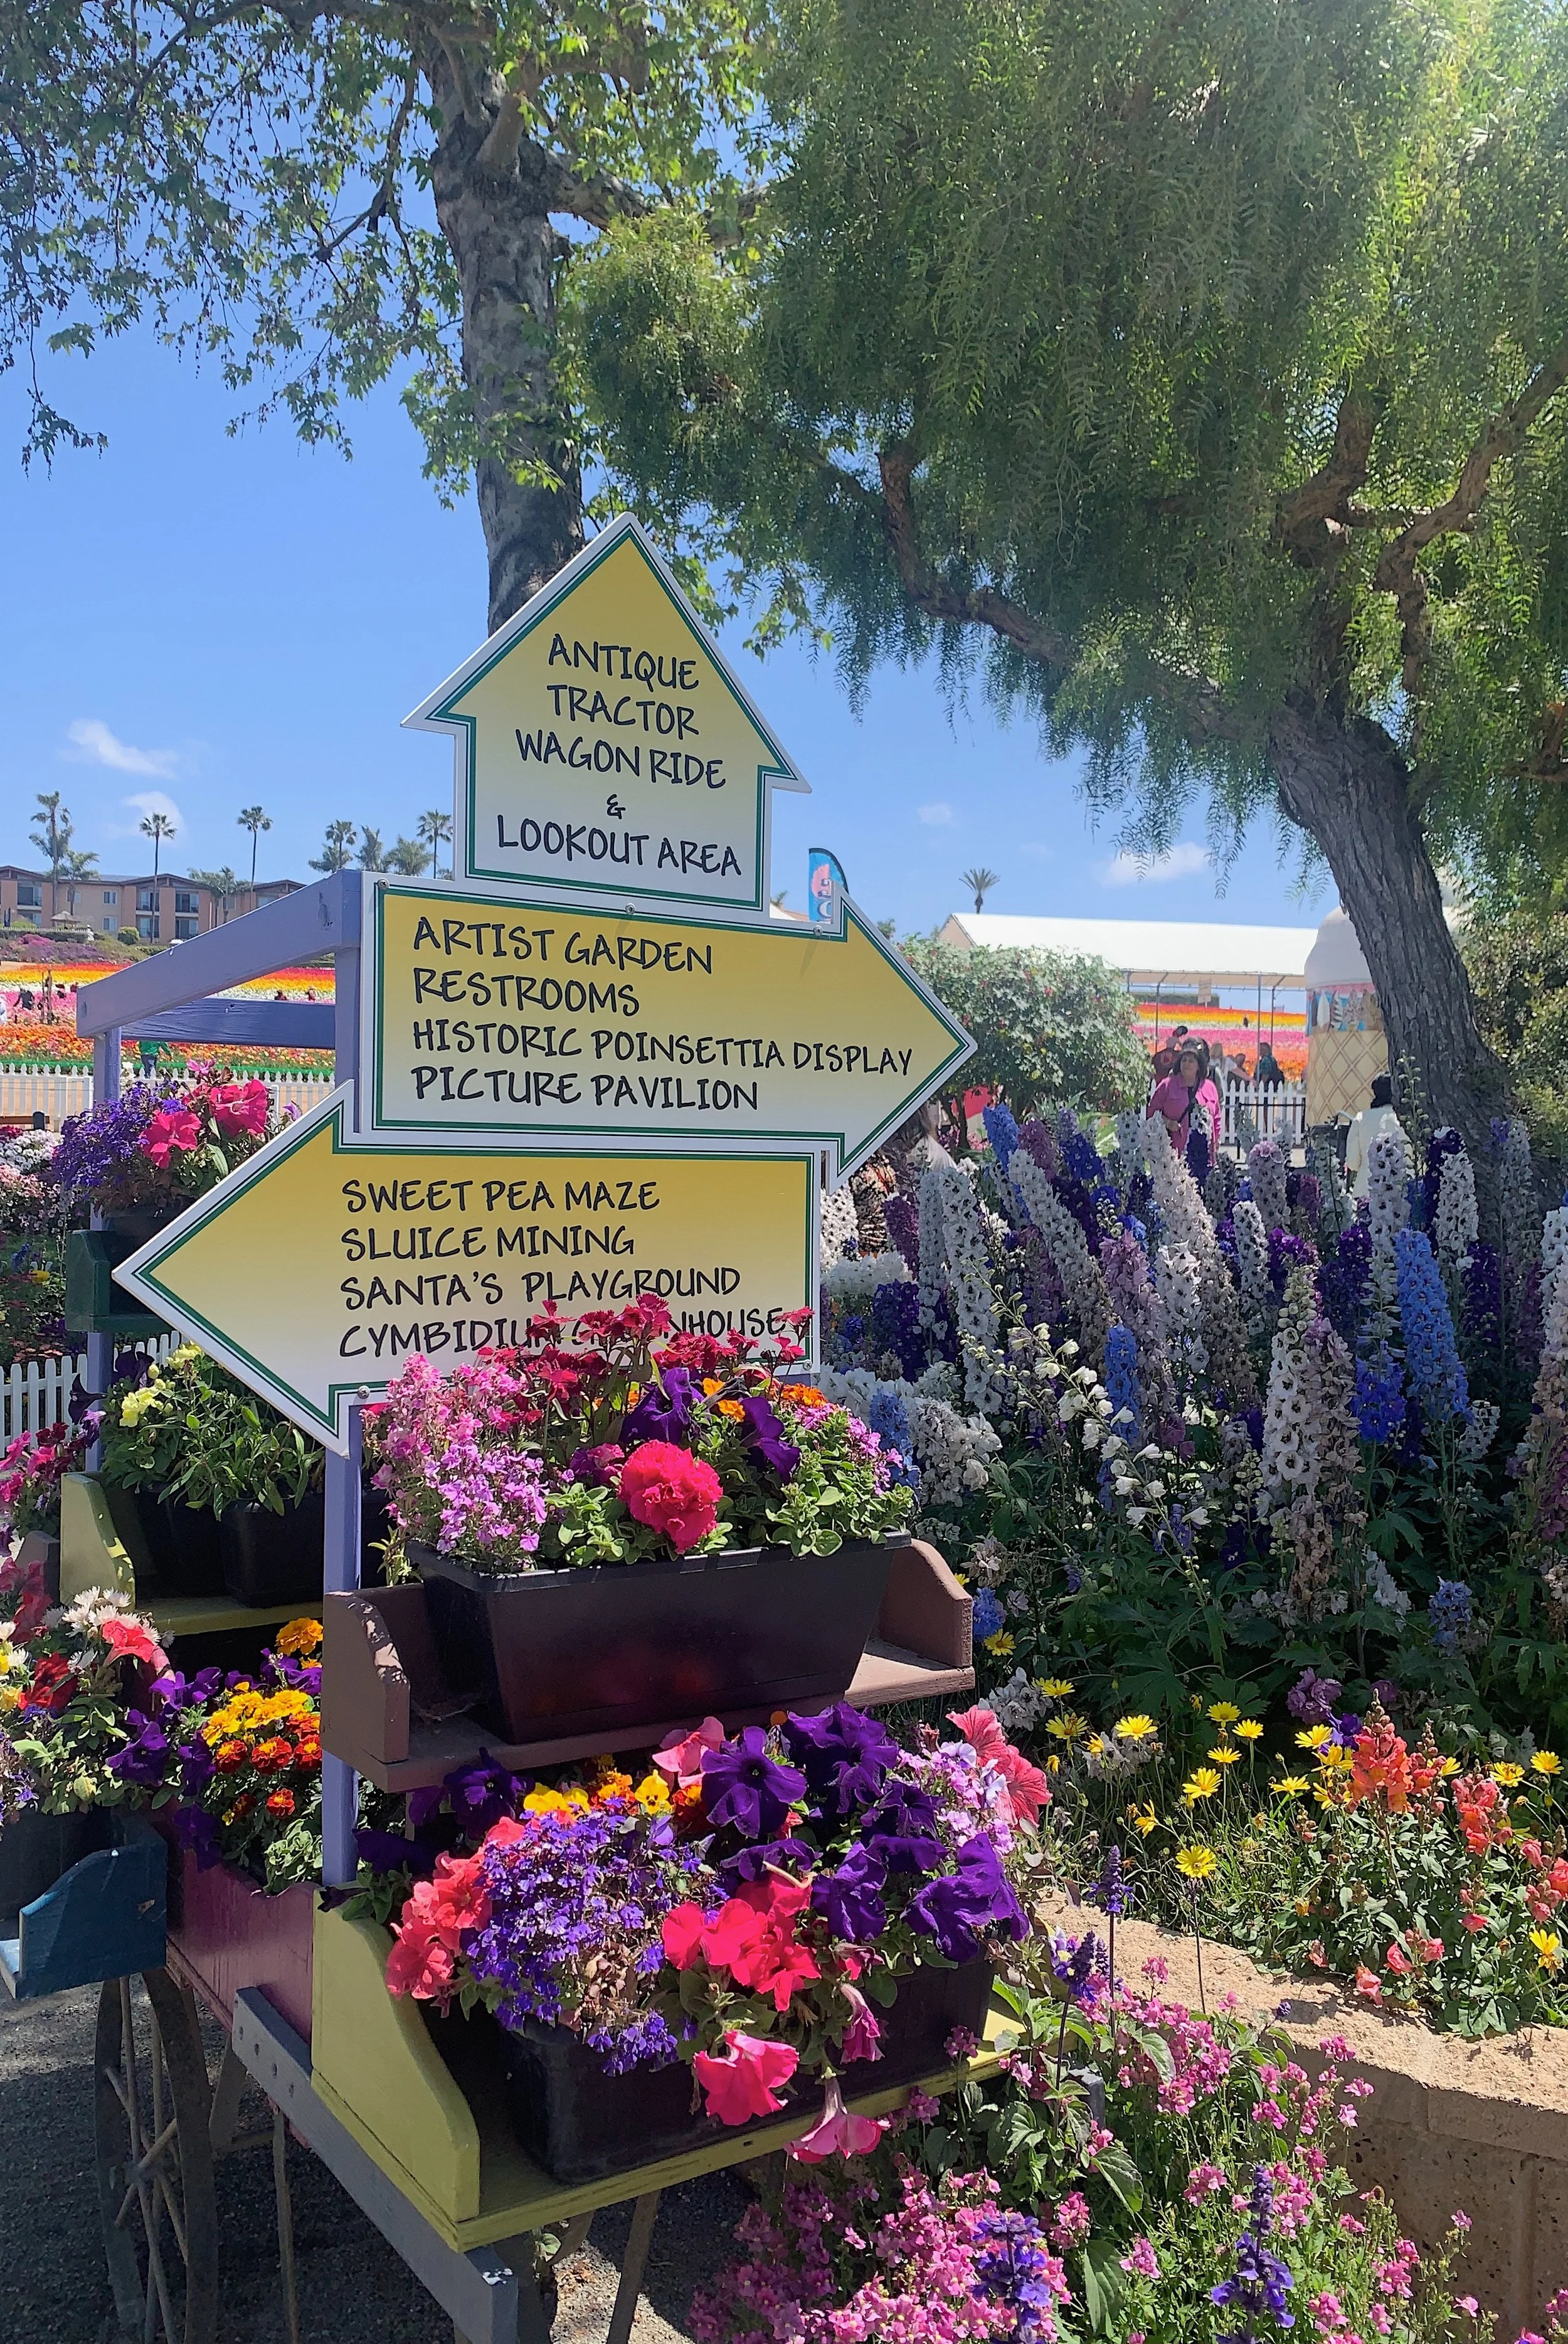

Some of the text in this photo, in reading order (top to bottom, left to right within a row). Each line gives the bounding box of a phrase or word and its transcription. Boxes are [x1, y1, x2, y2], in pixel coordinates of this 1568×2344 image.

[548, 633, 699, 693] ANTIQUE
[546, 684, 699, 740] TRACTOR
[515, 729, 726, 789] WAGON RIDE
[607, 793, 626, 820] &
[497, 814, 742, 877] LOOKOUT AREA
[413, 916, 712, 975] ARTIST GARDEN
[413, 967, 640, 1017] RESTROOMS
[413, 1019, 913, 1076] HISTORIC POINSETTIA DISPLAY
[410, 1066, 758, 1110] PICTURE PAVILION
[342, 1179, 660, 1213] SWEET PEA MAZE
[341, 1225, 634, 1261] SLUICE MINING
[340, 1266, 740, 1310] SANTA'S PLAYGROUND
[571, 1307, 786, 1346] NHOUSE
